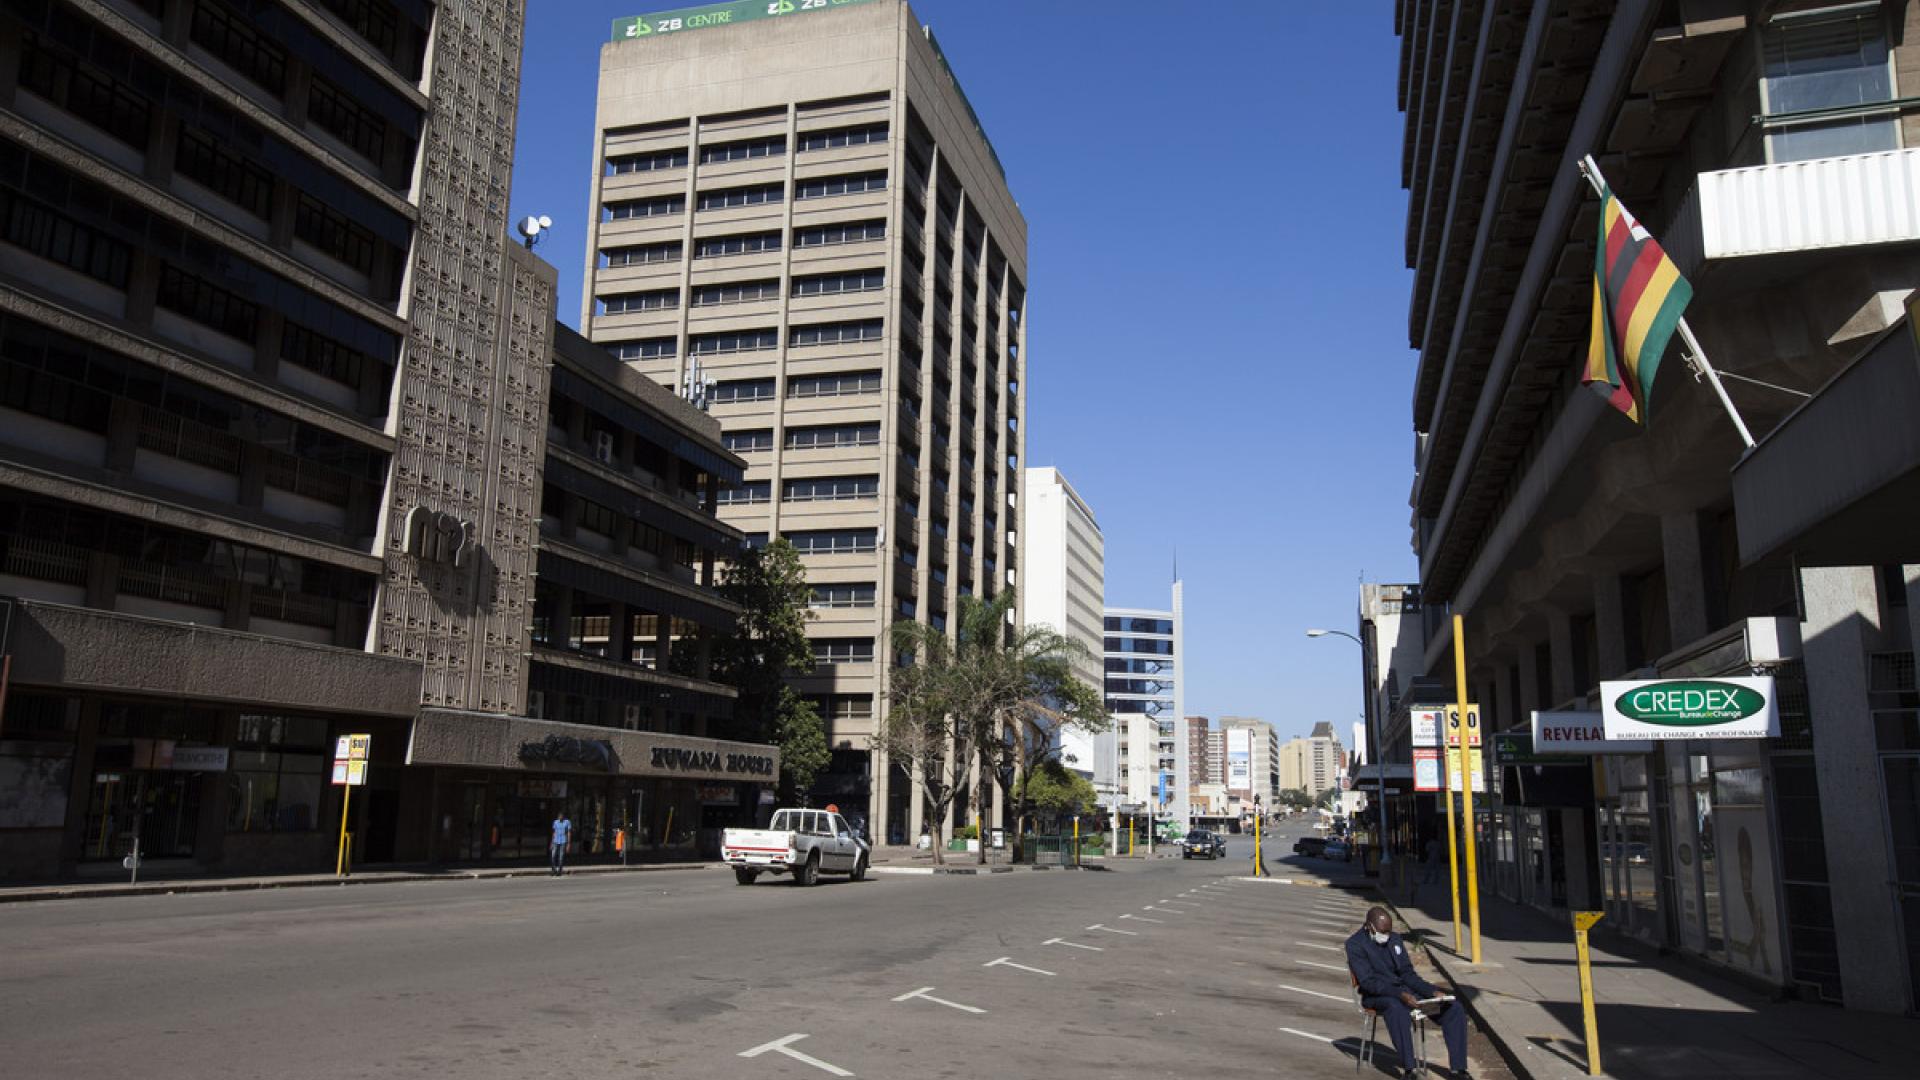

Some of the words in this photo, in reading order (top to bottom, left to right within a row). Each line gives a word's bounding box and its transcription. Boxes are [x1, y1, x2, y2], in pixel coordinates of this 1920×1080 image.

[657, 18, 682, 32] ZB
[687, 10, 732, 28] CENTRE
[1632, 688, 1741, 713] CREDEX
[1543, 726, 1605, 741] REVELA
[650, 747, 722, 772] KUWANA
[726, 753, 774, 775] HOUSE
